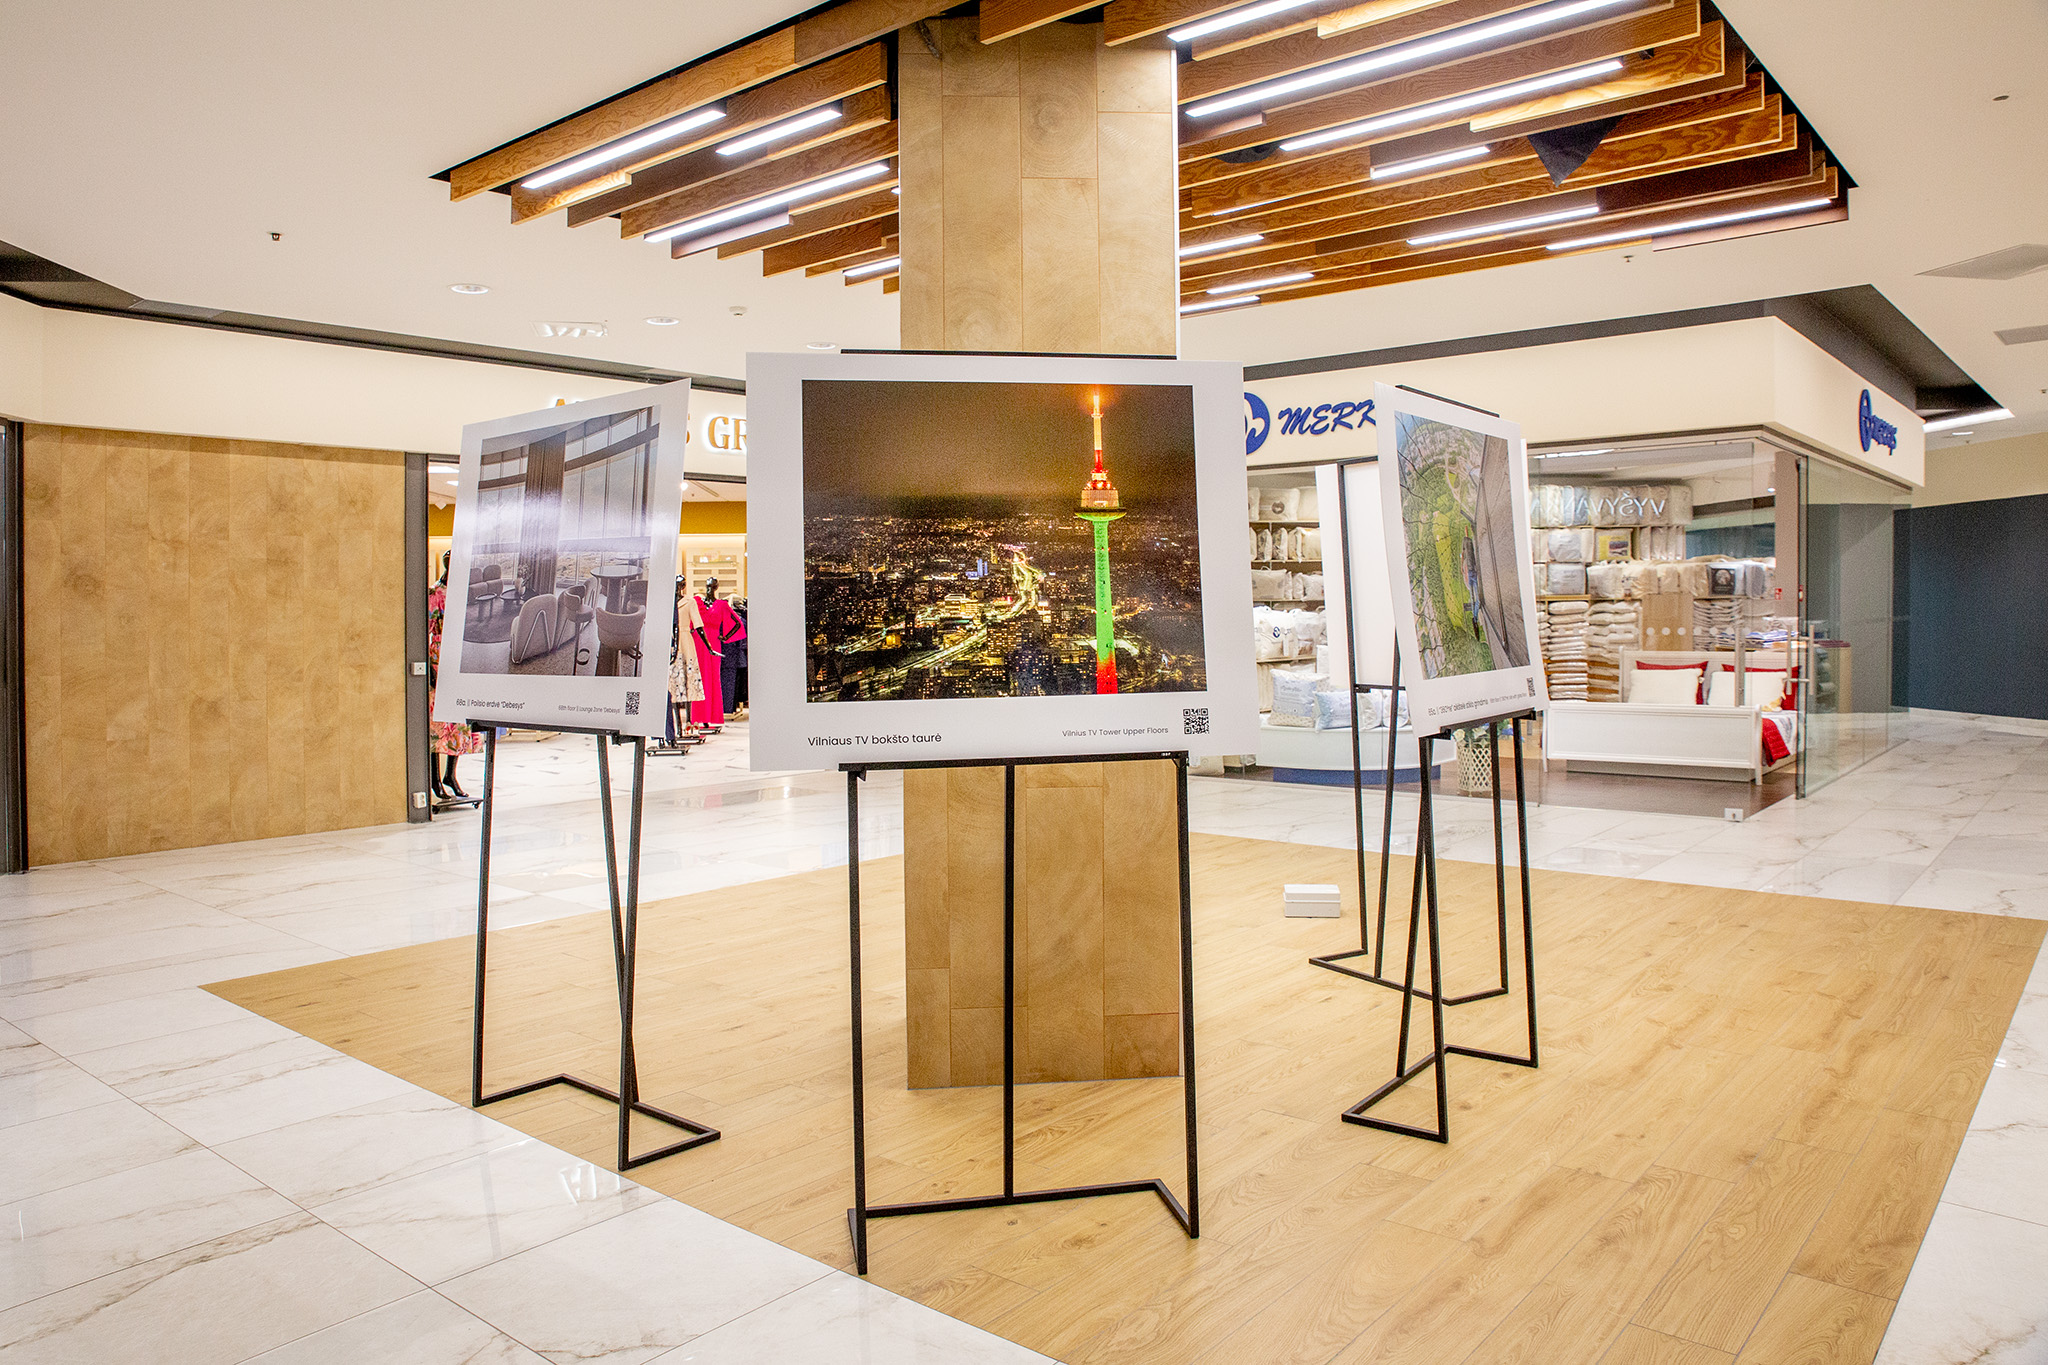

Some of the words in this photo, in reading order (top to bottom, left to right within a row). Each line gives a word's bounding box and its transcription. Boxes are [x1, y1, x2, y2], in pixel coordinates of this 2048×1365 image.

[1061, 729, 1087, 738] Vilnius
[1088, 729, 1098, 737] TV
[1099, 728, 1121, 736] Tower
[1122, 727, 1146, 737] Upper
[1146, 726, 1169, 735] Floors
[807, 735, 852, 747] Vilniaus
[855, 735, 869, 745] TV
[871, 733, 910, 745] bokšto
[912, 732, 942, 744] taurė
